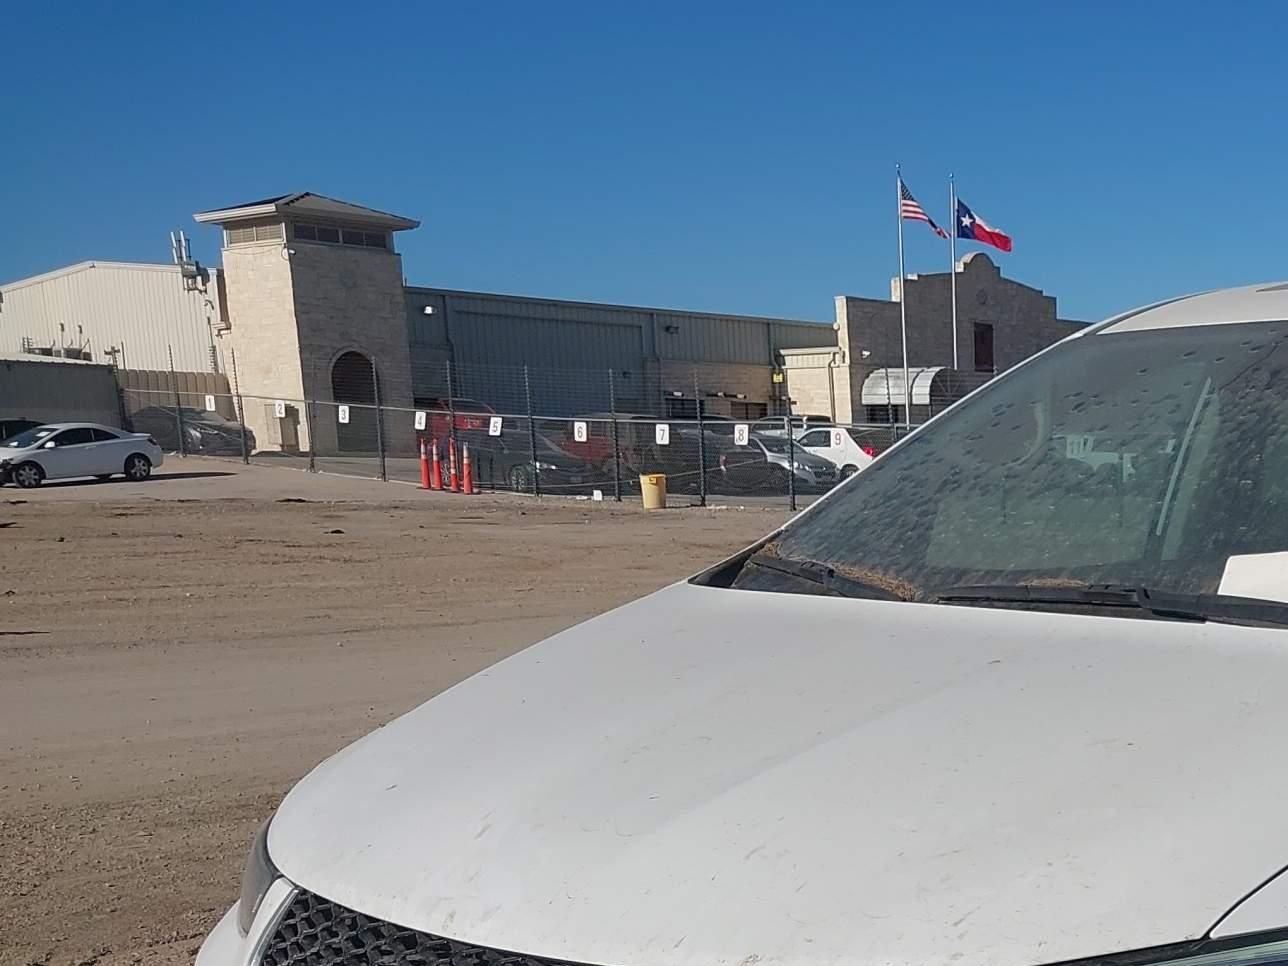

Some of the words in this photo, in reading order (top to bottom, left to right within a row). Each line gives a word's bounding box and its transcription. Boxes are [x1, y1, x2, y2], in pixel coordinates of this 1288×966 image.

[493, 421, 499, 433] 5
[577, 426, 583, 439] 6
[660, 429, 666, 441] 7
[738, 429, 744, 442] 8
[834, 432, 842, 446] 9
